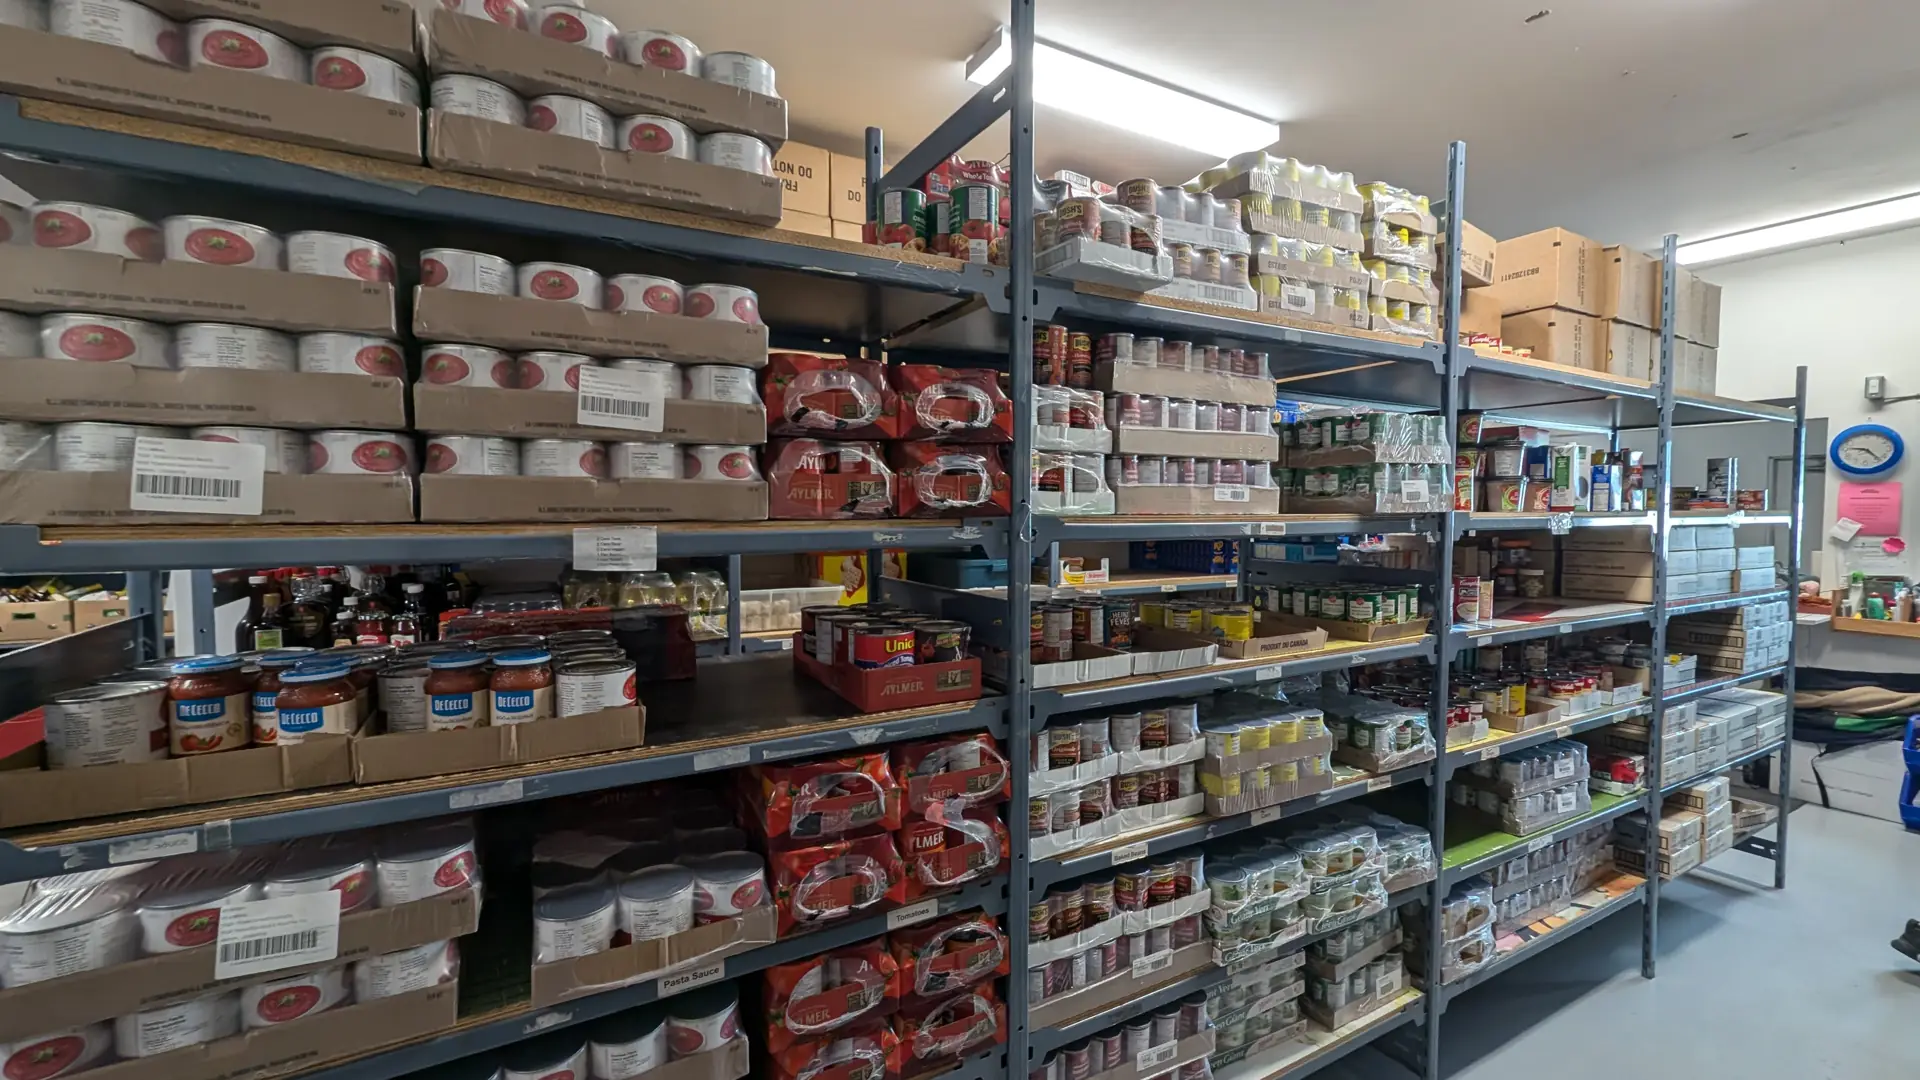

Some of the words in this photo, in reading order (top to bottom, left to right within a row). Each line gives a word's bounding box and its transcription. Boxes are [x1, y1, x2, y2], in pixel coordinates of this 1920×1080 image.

[773, 160, 795, 175] NOT
[798, 165, 812, 179] DO
[848, 190, 861, 202] DO
[881, 681, 925, 696] AYLMER
[896, 908, 930, 922] Tomatoes
[664, 976, 690, 989] Pasta
[692, 967, 720, 981] Sauce
